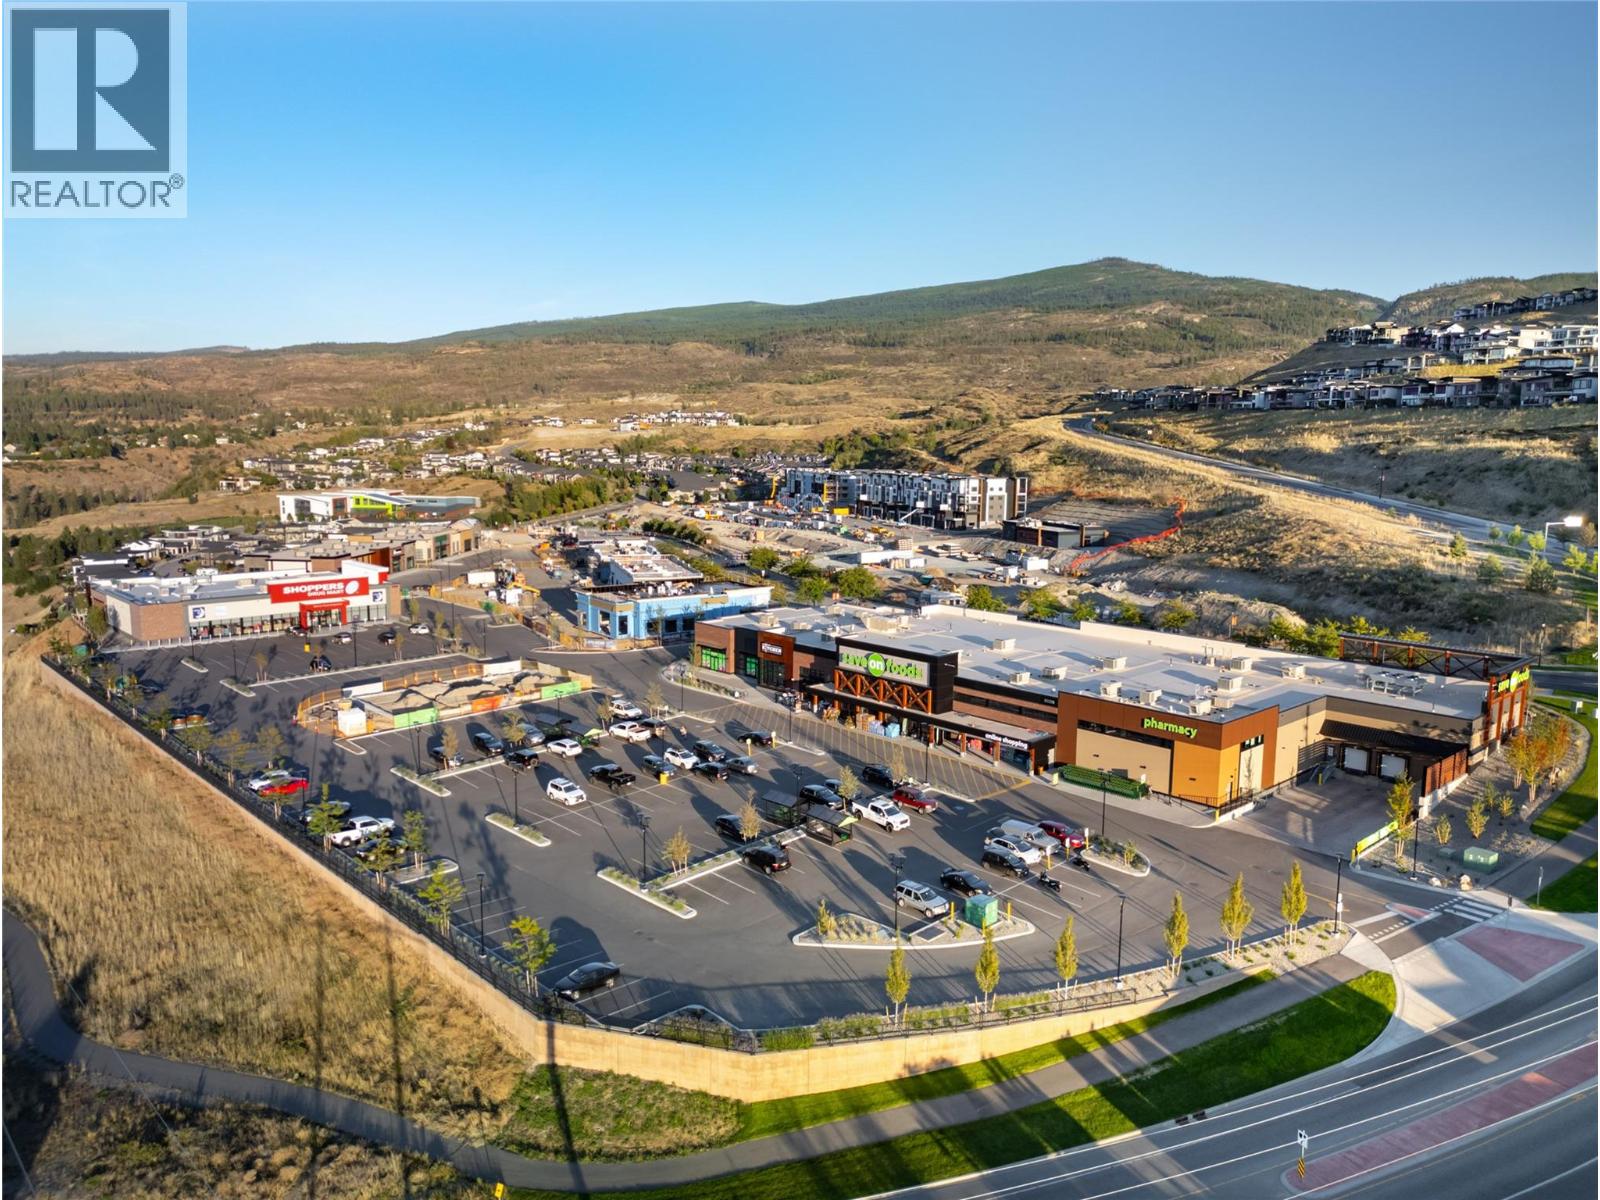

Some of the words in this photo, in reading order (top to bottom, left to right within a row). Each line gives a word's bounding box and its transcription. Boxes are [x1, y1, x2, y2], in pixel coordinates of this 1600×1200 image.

[283, 582, 344, 595] SHOPPERS
[841, 652, 868, 667] save
[886, 658, 923, 679] foods
[1144, 717, 1198, 739] pharmacy
